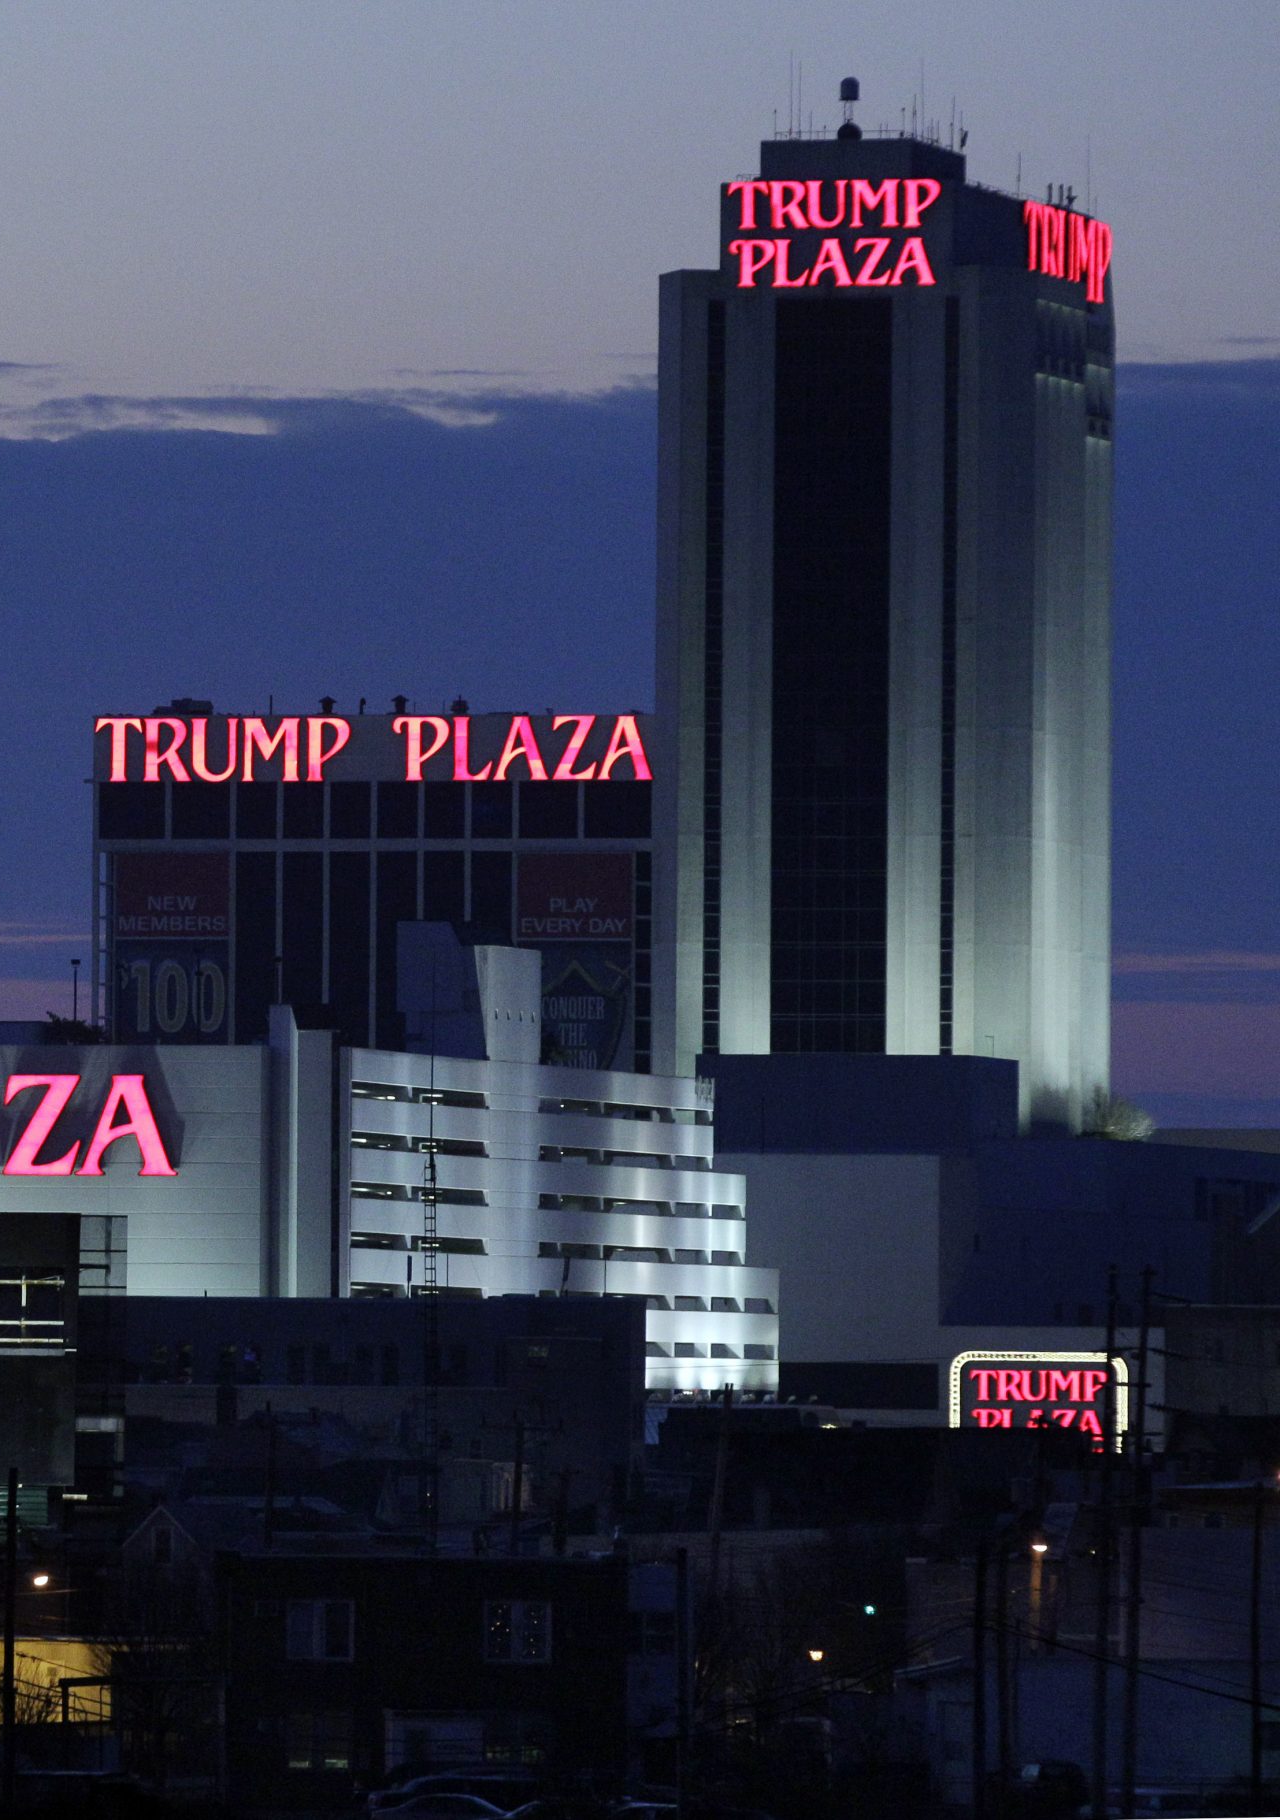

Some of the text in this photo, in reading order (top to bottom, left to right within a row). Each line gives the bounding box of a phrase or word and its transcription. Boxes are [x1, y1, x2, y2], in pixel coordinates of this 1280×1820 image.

[728, 179, 942, 229] TRUMP
[729, 237, 936, 287] PLAZA
[95, 714, 653, 783] TRUMP PLAZA
[147, 895, 197, 911] NEW
[549, 897, 598, 913] PLAY
[118, 915, 225, 932] MEMBERS
[521, 918, 627, 934] EVERY DAY
[541, 995, 606, 1021] CONQUER
[559, 1022, 588, 1046] THE
[970, 1369, 1108, 1402] TRUMP
